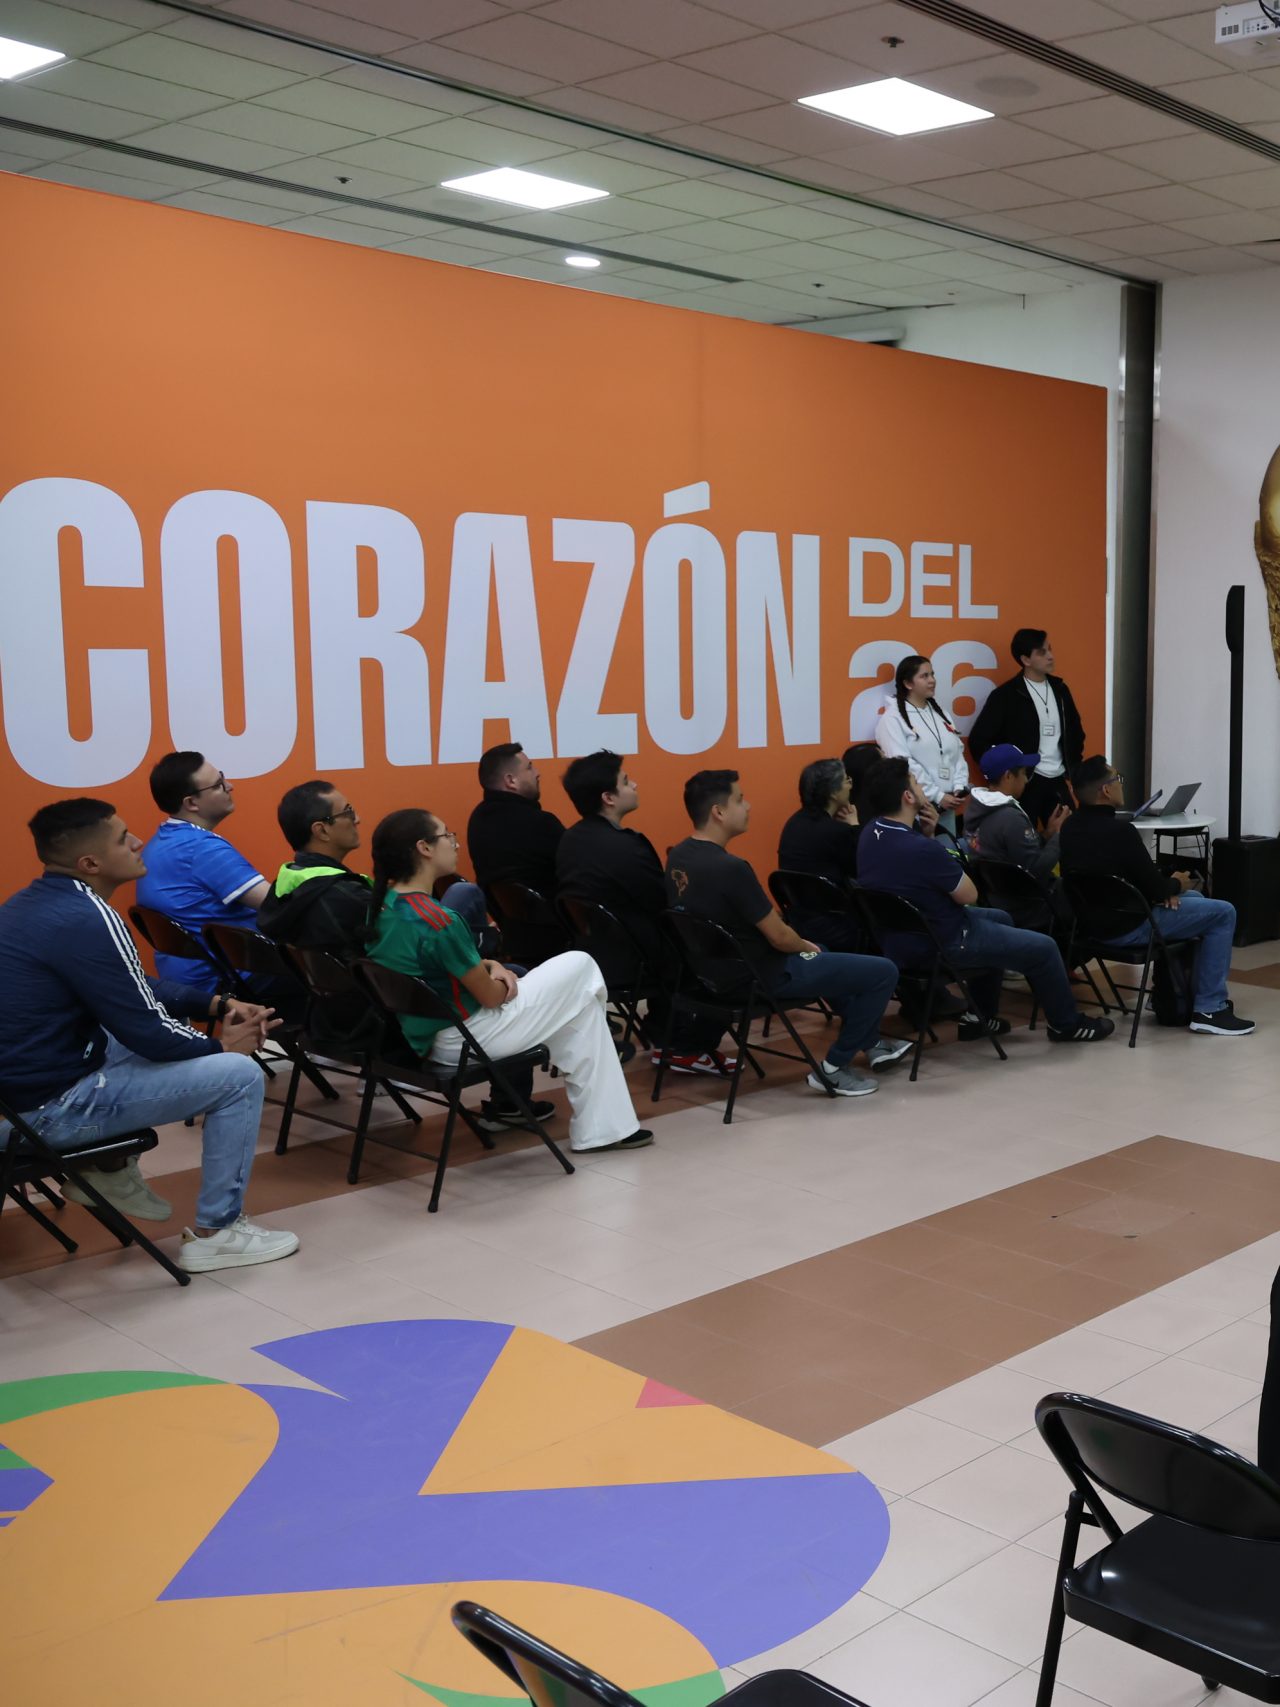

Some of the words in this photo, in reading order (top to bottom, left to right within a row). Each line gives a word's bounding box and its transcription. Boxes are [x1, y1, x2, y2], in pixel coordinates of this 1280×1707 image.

[849, 537, 998, 619] DEL
[0, 477, 820, 788] CORAZÓN
[849, 640, 998, 742] 26
